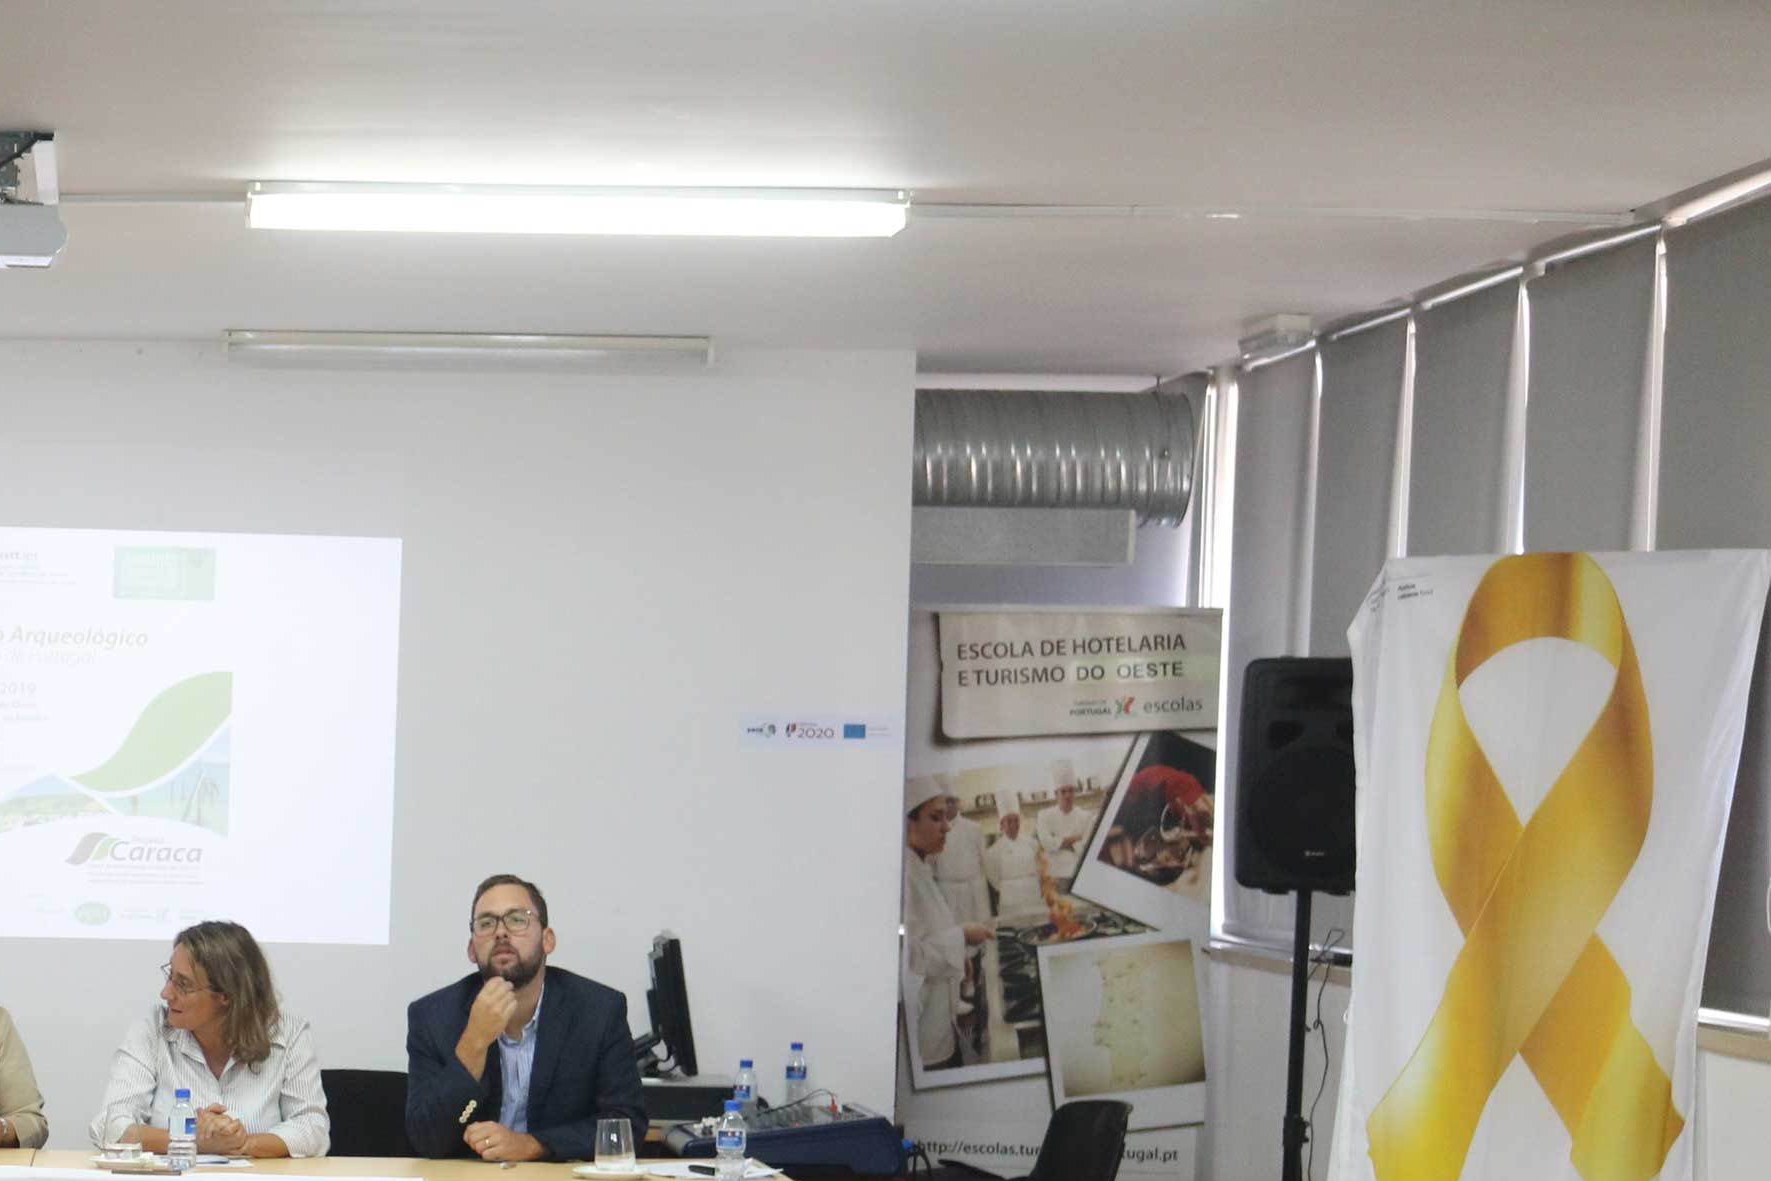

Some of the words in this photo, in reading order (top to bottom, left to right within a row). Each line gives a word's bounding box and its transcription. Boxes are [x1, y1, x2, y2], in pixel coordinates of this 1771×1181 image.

[10, 624, 149, 650] Arqueológico
[957, 641, 1033, 661] ESCOLA
[1041, 639, 1066, 657] DE
[1072, 633, 1186, 655] HOTELARIA
[958, 669, 969, 687] E
[972, 667, 1066, 687] TURISMO
[1076, 664, 1106, 682] DO
[1116, 660, 1185, 680] OESTE
[1069, 706, 1112, 716] PORTUGAL
[1143, 696, 1203, 713] escolas
[797, 728, 835, 739] 2020
[110, 841, 204, 863] Caraca
[918, 1139, 1179, 1163] http://escolas.turtugal.pt
